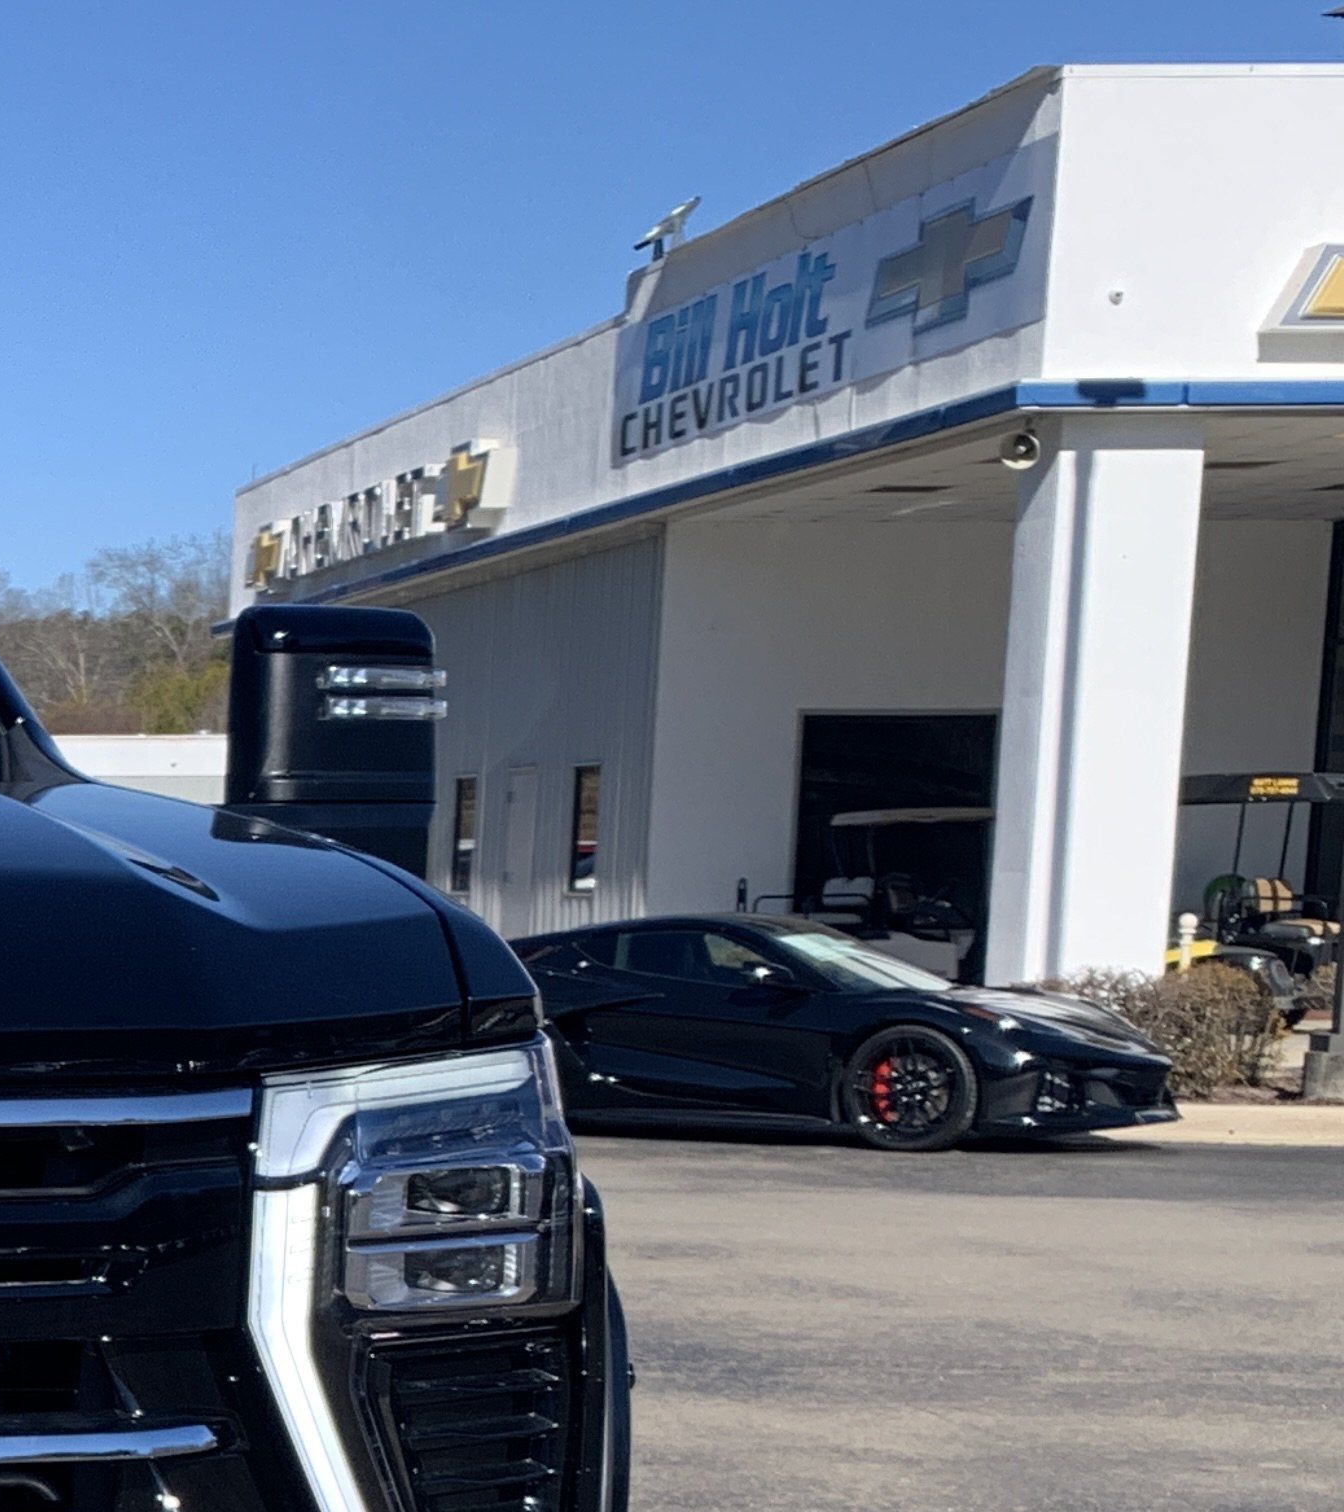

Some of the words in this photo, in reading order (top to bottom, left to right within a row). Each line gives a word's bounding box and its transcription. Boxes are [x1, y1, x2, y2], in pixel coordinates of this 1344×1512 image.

[620, 329, 852, 457] CHEVROLET
[638, 294, 718, 405] Bill
[723, 252, 837, 372] Holt
